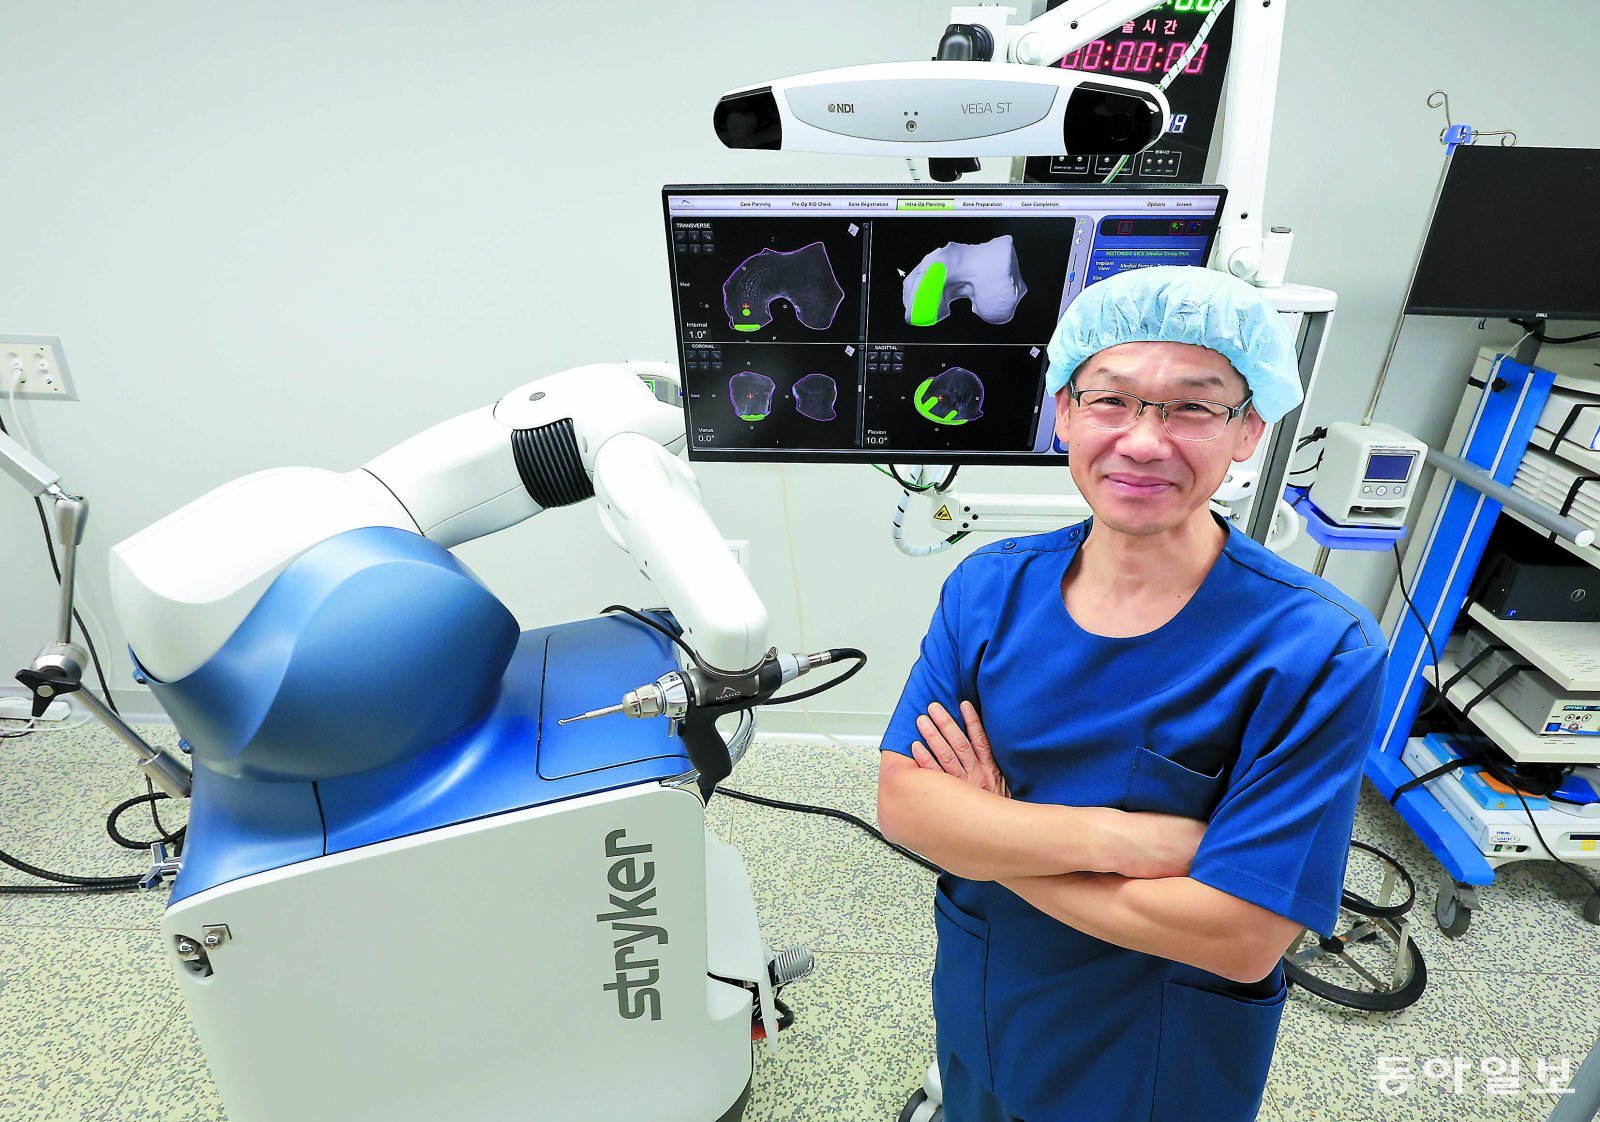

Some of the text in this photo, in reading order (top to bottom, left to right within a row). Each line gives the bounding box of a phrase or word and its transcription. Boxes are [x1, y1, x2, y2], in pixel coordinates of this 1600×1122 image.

[836, 103, 855, 114] NDI
[961, 102, 1012, 115] VEGA ST
[689, 330, 707, 339] 1.0°
[698, 434, 715, 442] 0.0°
[866, 436, 888, 445] 10.0°
[715, 690, 741, 701] MAKO
[596, 828, 669, 1022] stryker
